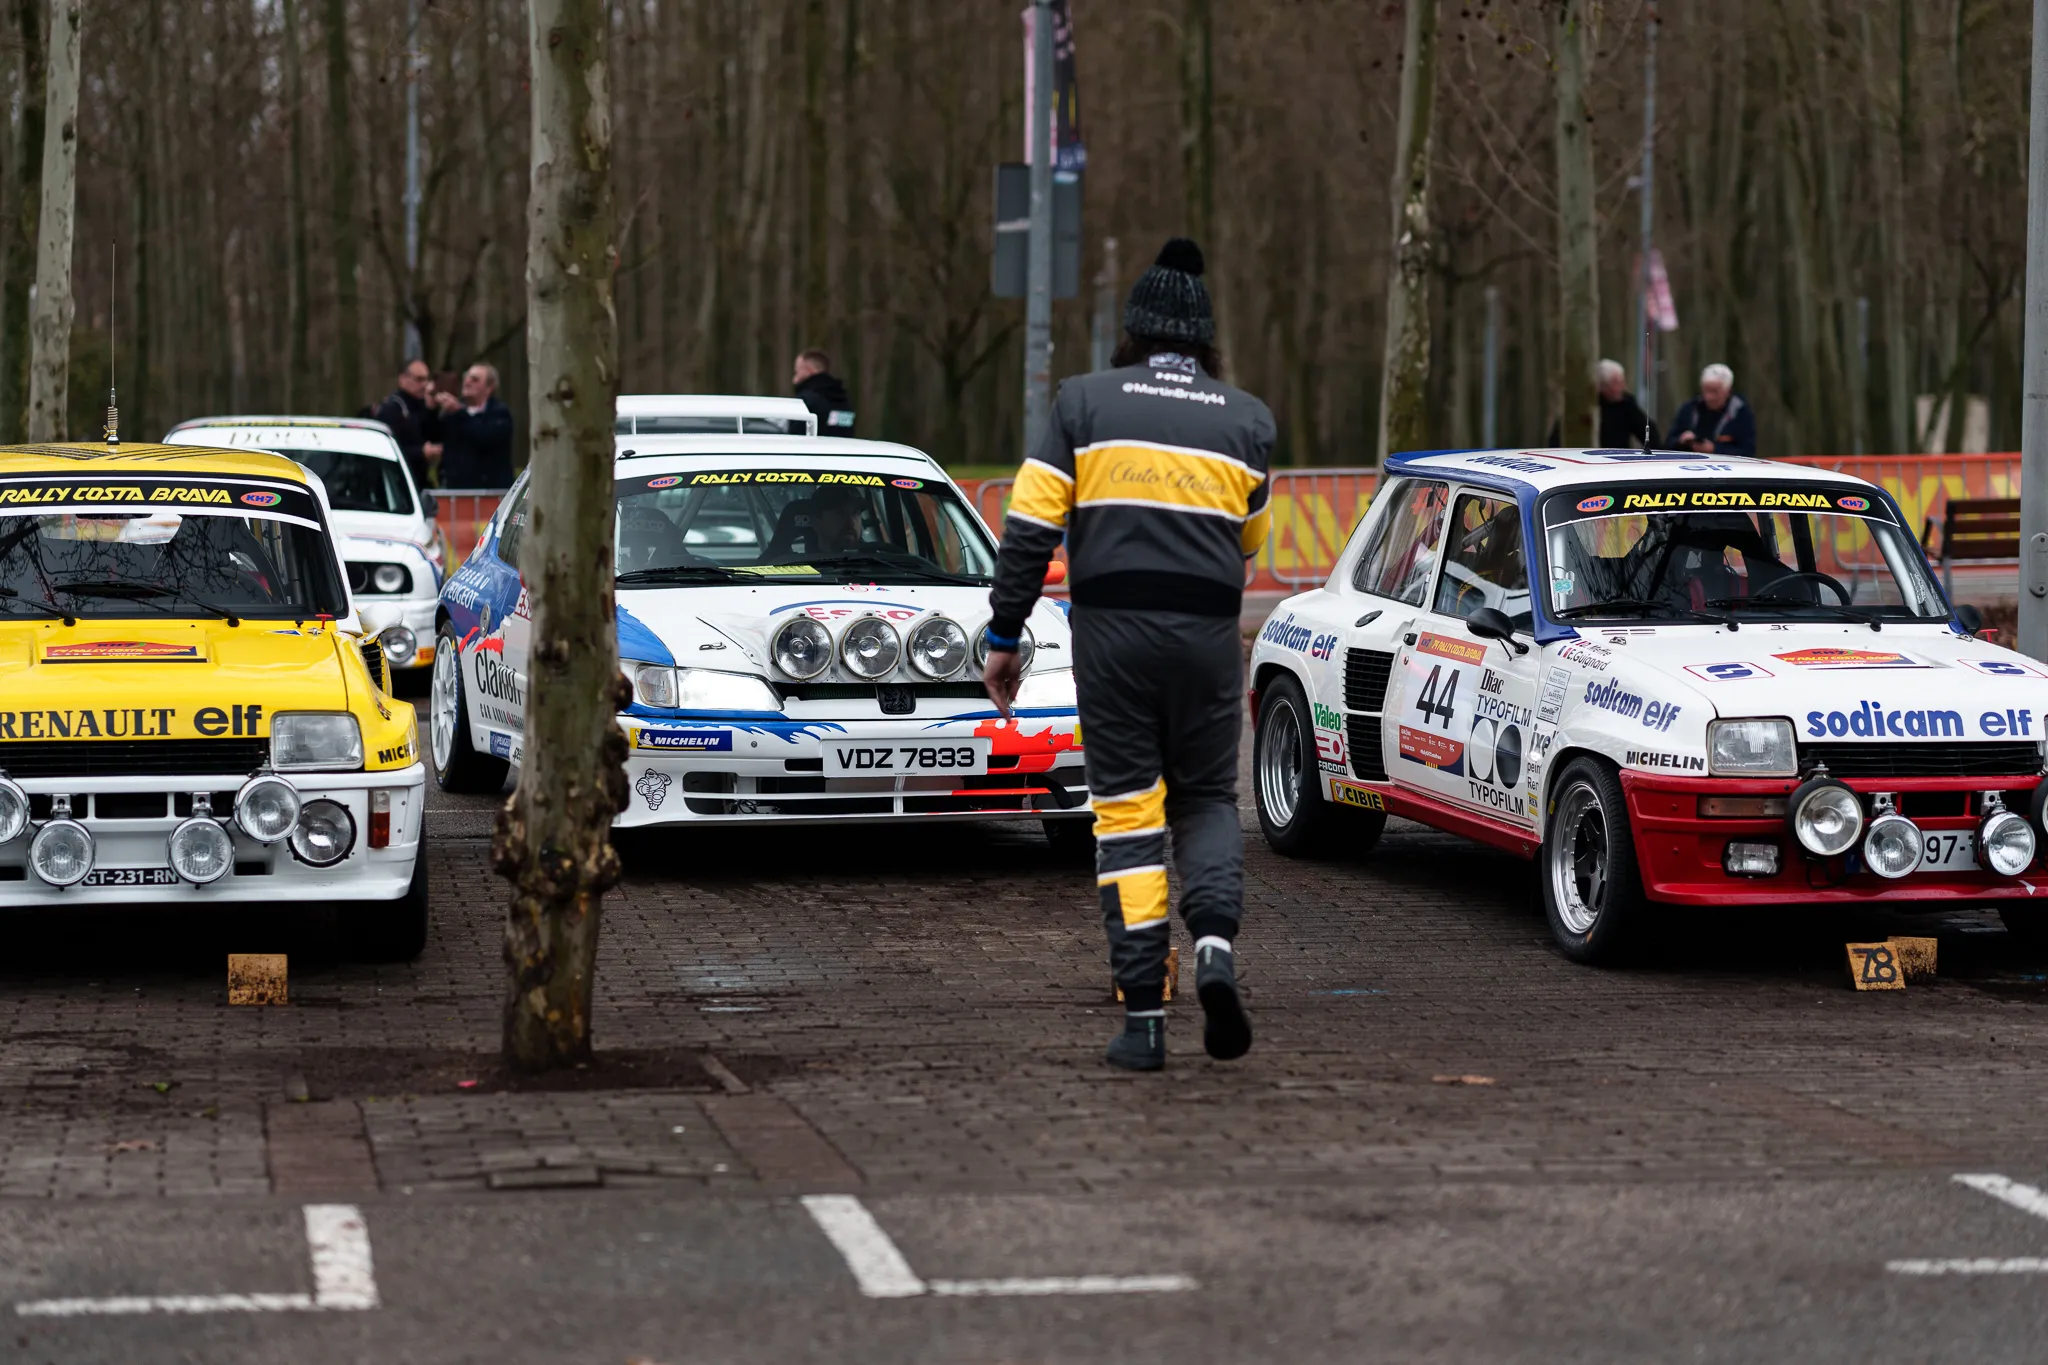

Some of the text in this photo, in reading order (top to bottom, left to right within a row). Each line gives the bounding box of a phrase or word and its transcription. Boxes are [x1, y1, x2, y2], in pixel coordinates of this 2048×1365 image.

[1122, 382, 1226, 406] @MartinBrady44
[690, 473, 752, 485] RALLY
[755, 472, 815, 483] COSTA
[816, 474, 886, 486] BRAVA
[1110, 459, 1160, 484] Auto
[0, 487, 71, 503] RALLY
[73, 487, 145, 502] COSTA
[149, 488, 233, 503] BRAVA
[1623, 492, 1686, 507] RALLY
[1690, 492, 1756, 506] COSTA
[1759, 493, 1833, 508] BRAVA
[445, 581, 479, 610] PEUGEOT
[1262, 614, 1339, 662] sodicam elf
[1479, 668, 1505, 695] Diac
[1416, 664, 1460, 730] 44
[1477, 694, 1532, 727] TYPOFILM
[1584, 678, 1682, 733] sodicam elf
[0, 705, 262, 738] RENAULT elf
[1314, 702, 1341, 732] Valeo
[1806, 700, 2032, 737] sodicam elf
[655, 737, 720, 746] MICHELIN
[837, 747, 975, 768] VDZ 7833
[1318, 760, 1346, 774] FACOM
[1626, 751, 1704, 771] MICHELIN
[1469, 781, 1524, 817] TYPOFILM
[84, 869, 176, 884] GT-231-RN
[1852, 946, 1897, 983] 78
